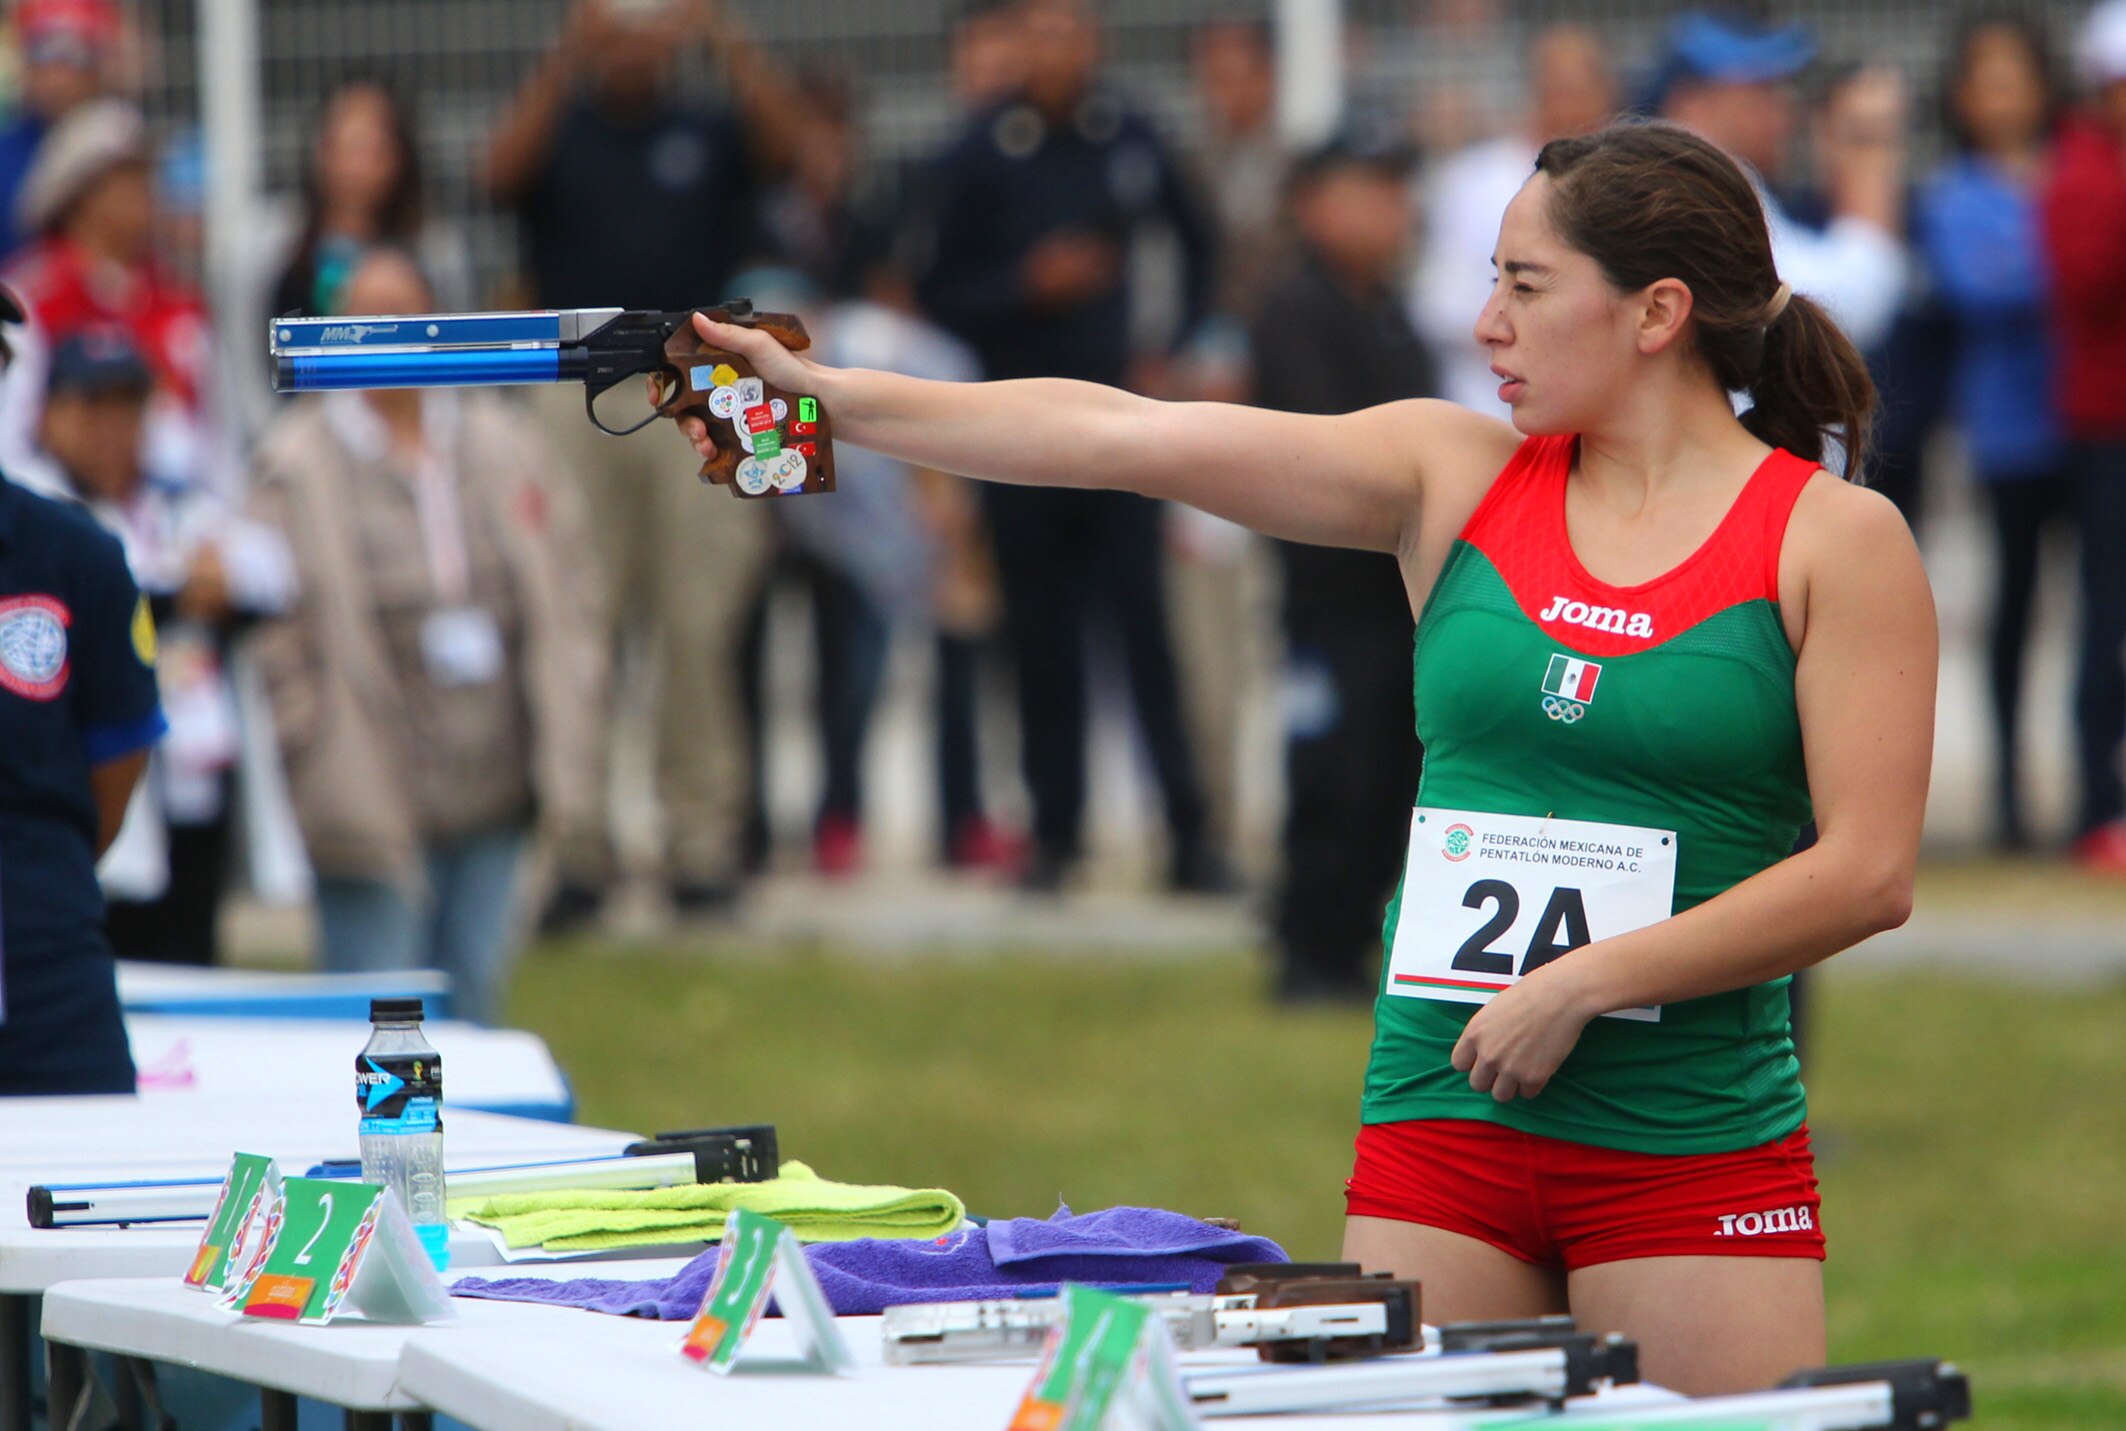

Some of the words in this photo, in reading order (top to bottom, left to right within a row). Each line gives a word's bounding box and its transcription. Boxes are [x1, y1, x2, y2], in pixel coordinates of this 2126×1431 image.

[1540, 596, 1654, 638] Joma
[1480, 848, 1549, 863] PENTATLÓN
[1552, 854, 1614, 869] MODERNO
[1616, 861, 1641, 873] A.C.
[1482, 833, 1557, 849] FEDERACIÓN
[1560, 840, 1622, 855] MEXICANA
[1626, 846, 1644, 858] DE
[1451, 879, 1592, 976] 2A
[294, 1192, 334, 1265] 2
[1713, 1205, 1813, 1236] Joma
